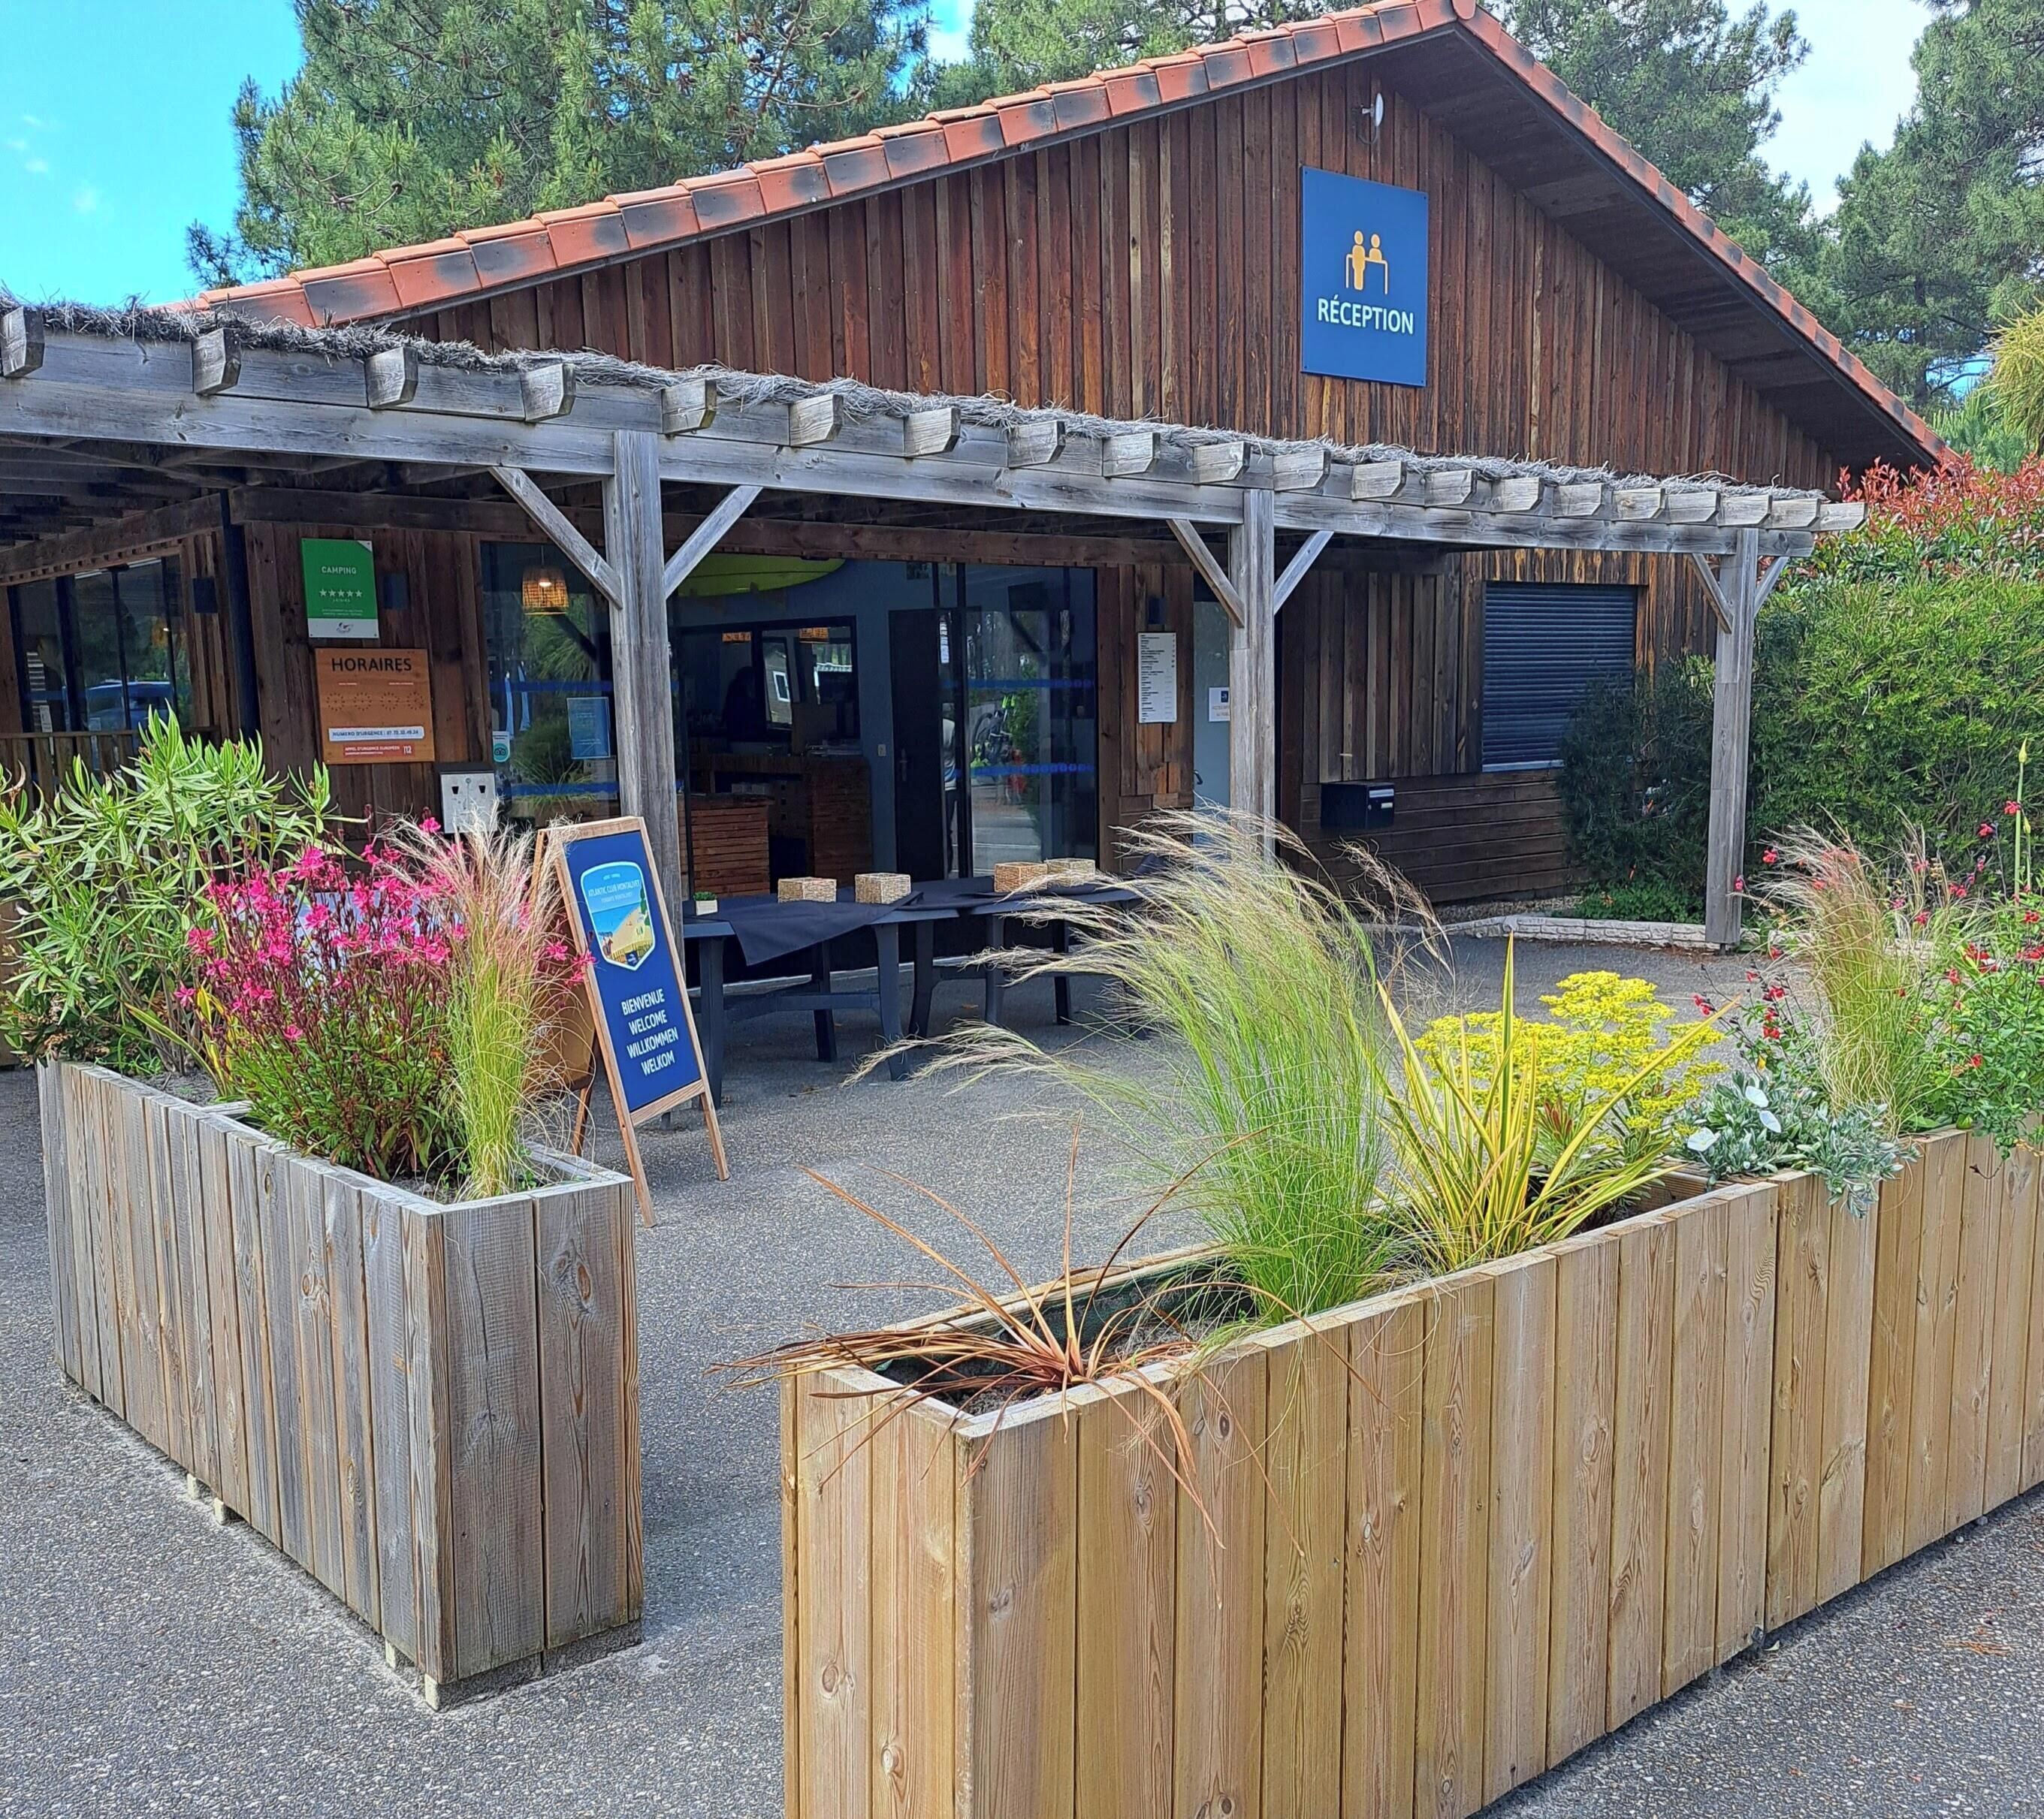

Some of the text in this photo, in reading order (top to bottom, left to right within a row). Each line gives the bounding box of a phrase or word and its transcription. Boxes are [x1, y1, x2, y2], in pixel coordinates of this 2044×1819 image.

[1318, 294, 1414, 335] RÉCEPTION
[322, 566, 357, 575] CAMPING
[331, 658, 412, 672] HORAIRES
[403, 745, 412, 754] 112
[621, 988, 665, 1015] BIENVENUE
[628, 1009, 667, 1036] WELCOME
[626, 1027, 679, 1059] WILLKOMMEN
[641, 1050, 675, 1076] WELKOM
